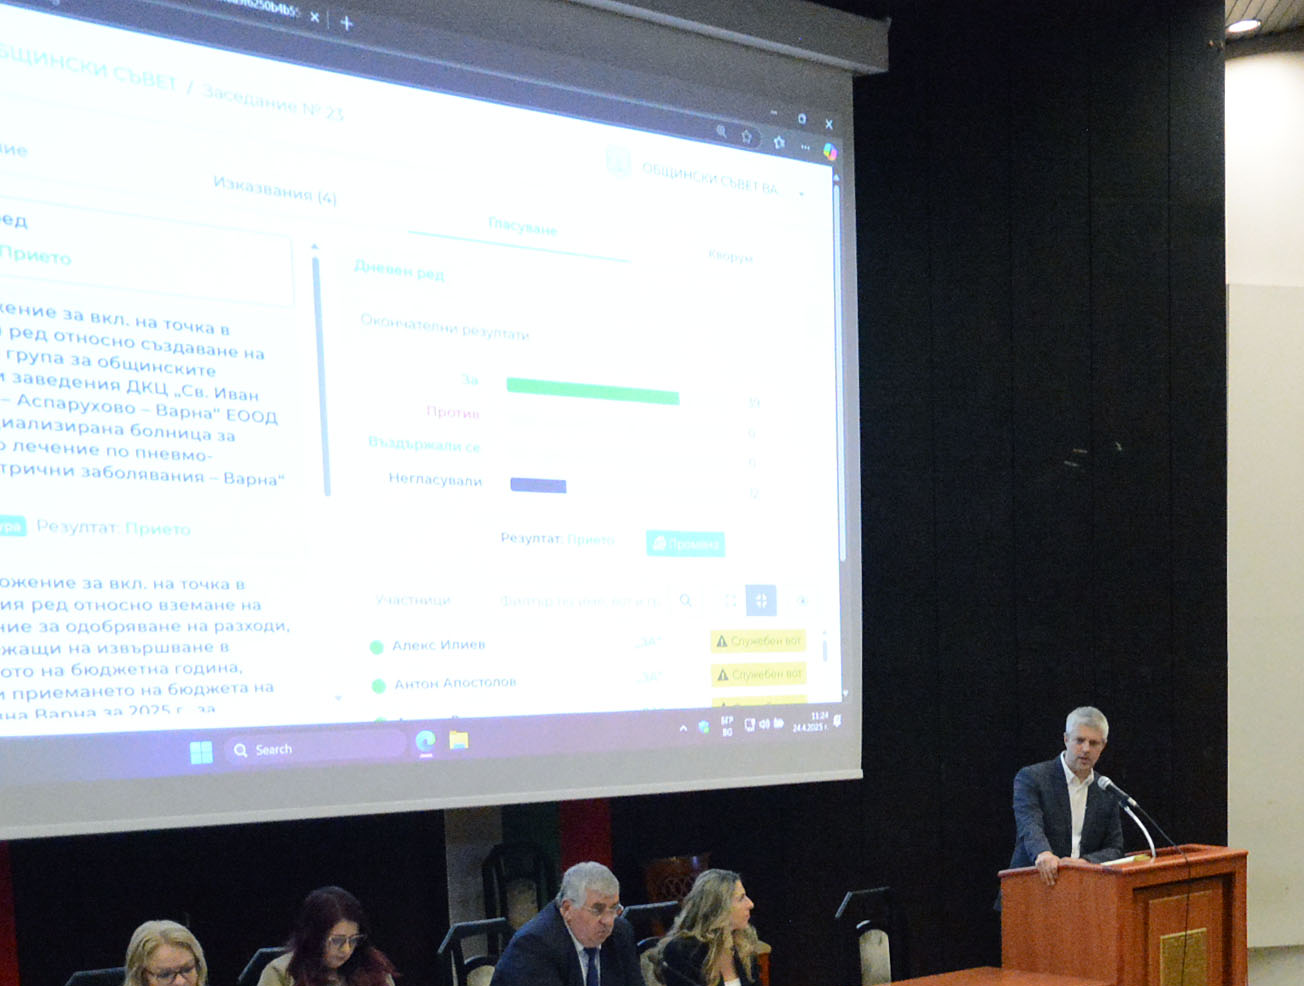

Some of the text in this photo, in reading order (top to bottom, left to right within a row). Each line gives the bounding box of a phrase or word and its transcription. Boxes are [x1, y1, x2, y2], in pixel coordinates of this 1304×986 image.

[112, 66, 177, 91] СЪВЕТ
[202, 82, 298, 113] Заседание
[213, 175, 338, 208] Изказвания (4)
[0, 212, 28, 230] ед
[487, 215, 559, 240] Гласуване
[708, 248, 755, 265] Кворум
[354, 257, 448, 284] Дневен ред
[63, 307, 84, 323] за
[90, 311, 130, 327] вкл.
[135, 315, 158, 330] на
[163, 318, 215, 335] точка
[220, 324, 231, 337] в
[360, 311, 530, 343] Окончателни резултати
[9, 326, 266, 361] ред относно създаване на
[6, 349, 217, 379] група за общинските
[12, 372, 121, 392] заведения
[126, 379, 170, 399] ДКЦ
[213, 386, 260, 403] Иван
[17, 393, 136, 416] Аспарухово
[226, 408, 279, 426] ЕООД
[426, 404, 480, 421] Против
[0, 416, 236, 443] иализирана болница за
[12, 441, 213, 464] лечение по пневмо-
[368, 434, 480, 454] Въздържали се
[81, 466, 205, 485] заболявания
[388, 471, 483, 488] Негласували
[37, 519, 121, 536] Резултат:
[125, 521, 192, 538] Прието
[567, 532, 617, 547] Прието
[82, 578, 103, 590] за
[109, 578, 148, 590] вкл.
[153, 578, 175, 590] на
[181, 578, 231, 591] точка
[236, 579, 247, 591] в
[31, 600, 69, 614] ред
[74, 599, 153, 612] относно
[159, 600, 236, 612] вземане
[241, 600, 262, 612] на
[375, 592, 454, 608] Участници
[39, 621, 60, 633] за
[66, 619, 181, 636] одобряване
[187, 620, 208, 633] на
[214, 620, 291, 635] разходи,
[68, 643, 91, 655] на
[97, 641, 214, 657] извършване
[220, 642, 230, 653] в
[392, 639, 437, 652] Алекс
[440, 638, 486, 651] Илиев
[41, 665, 65, 678] на
[71, 662, 169, 679] бюджетна
[175, 662, 243, 677] година,
[12, 682, 275, 703] приемането на бюджета на
[394, 679, 440, 691] Антон
[442, 675, 518, 690] Апостолов
[255, 743, 293, 757] Search
